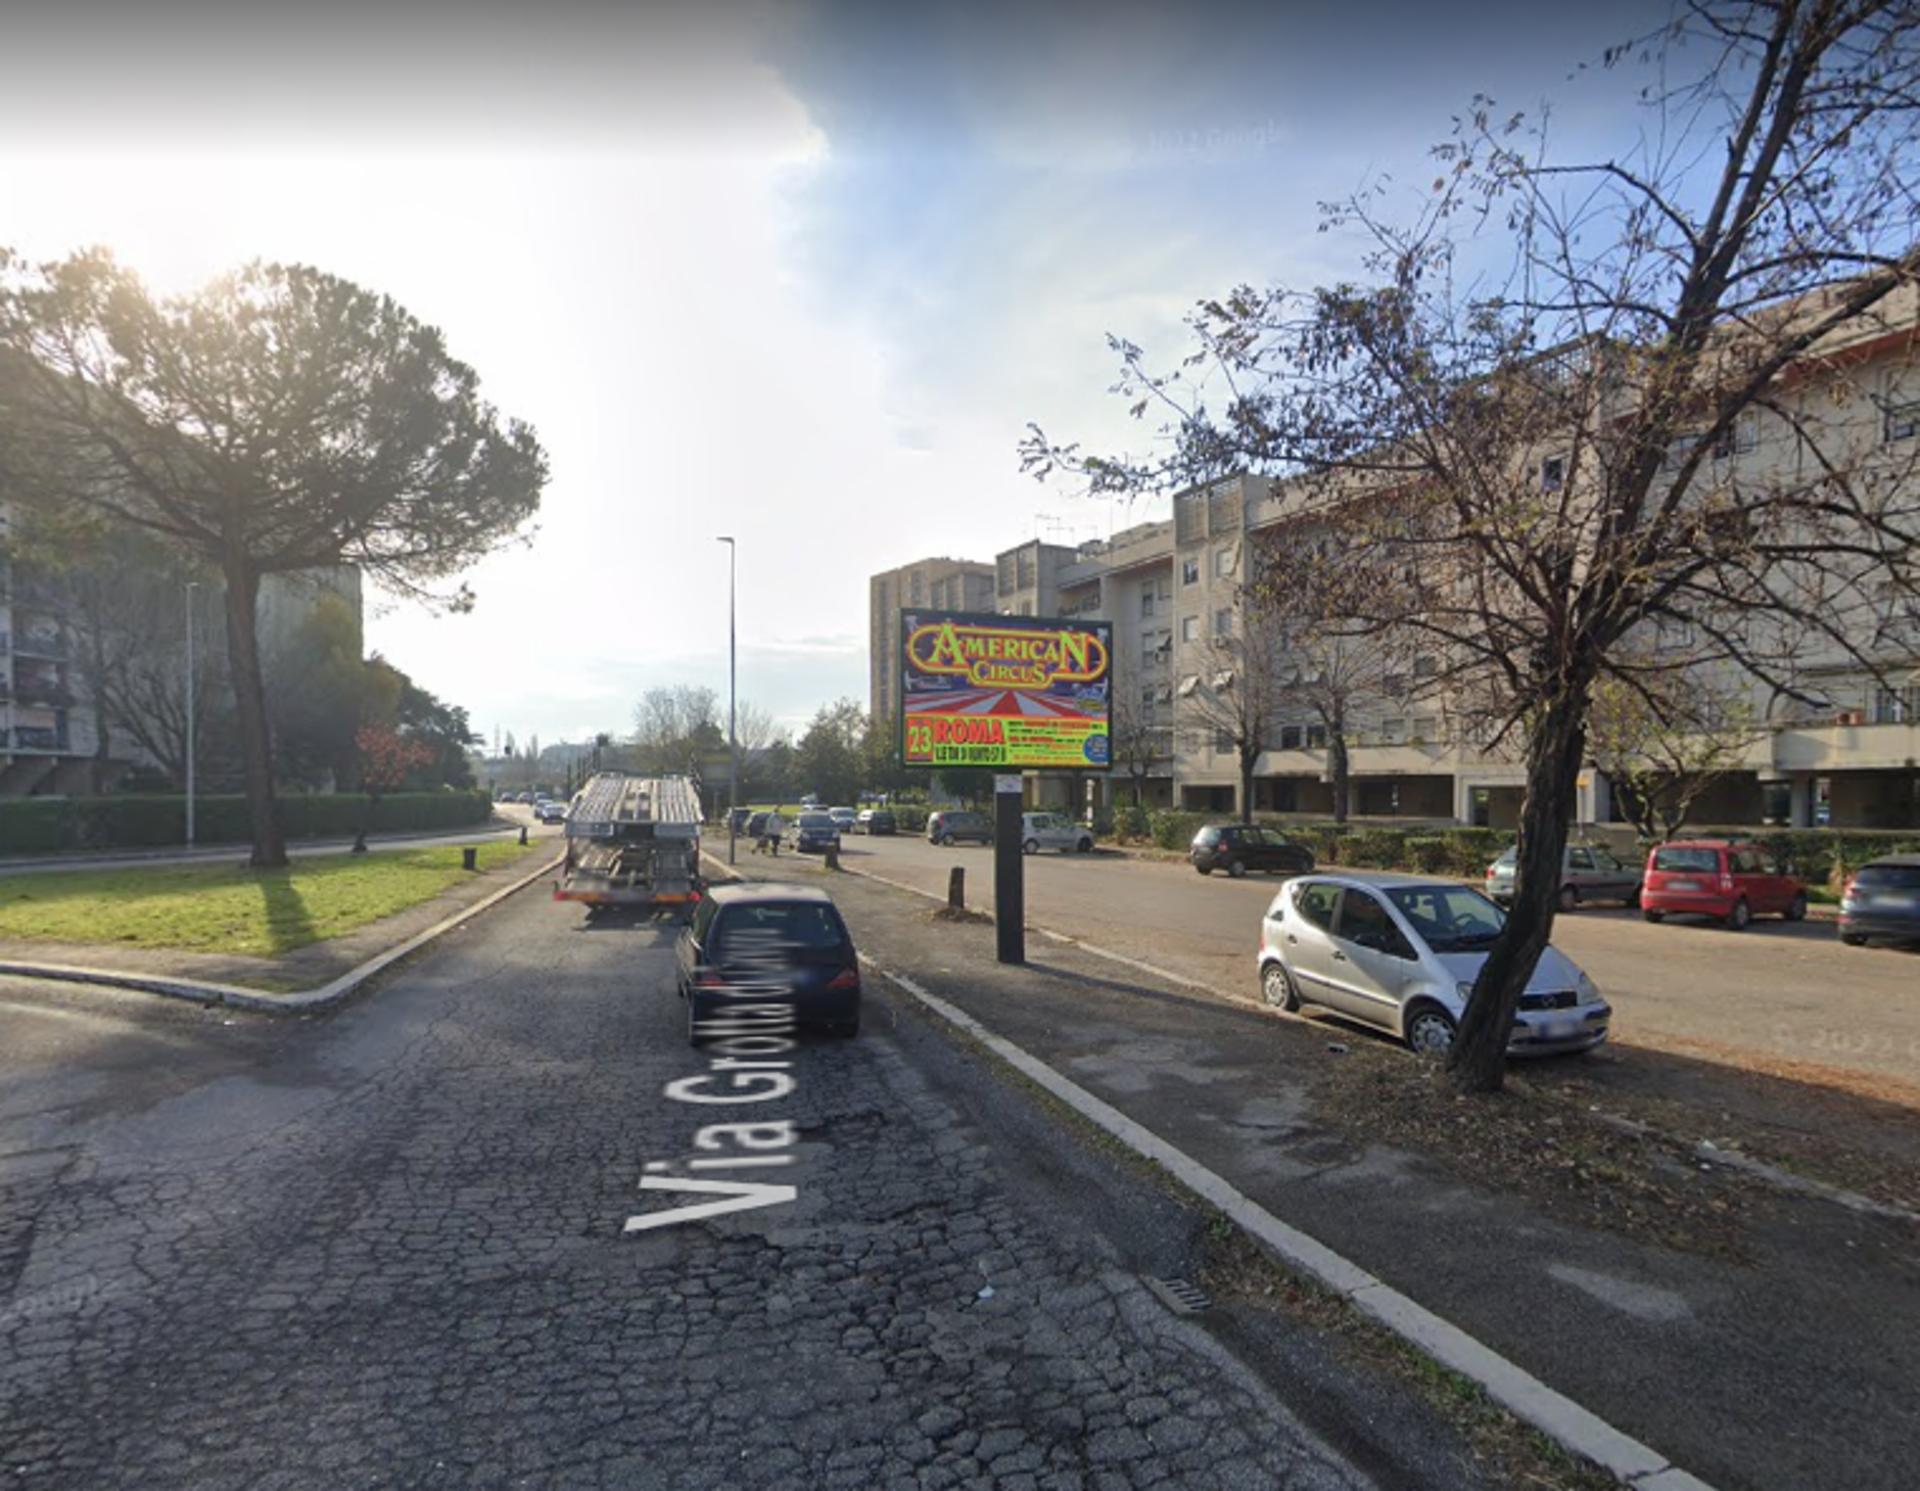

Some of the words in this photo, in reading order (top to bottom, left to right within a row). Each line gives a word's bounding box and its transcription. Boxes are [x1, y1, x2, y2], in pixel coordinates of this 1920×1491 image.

[928, 623, 1088, 672] AMERICAN
[973, 660, 1046, 683] CIRCUS
[908, 725, 931, 752] 23
[934, 719, 1005, 744] ROMA
